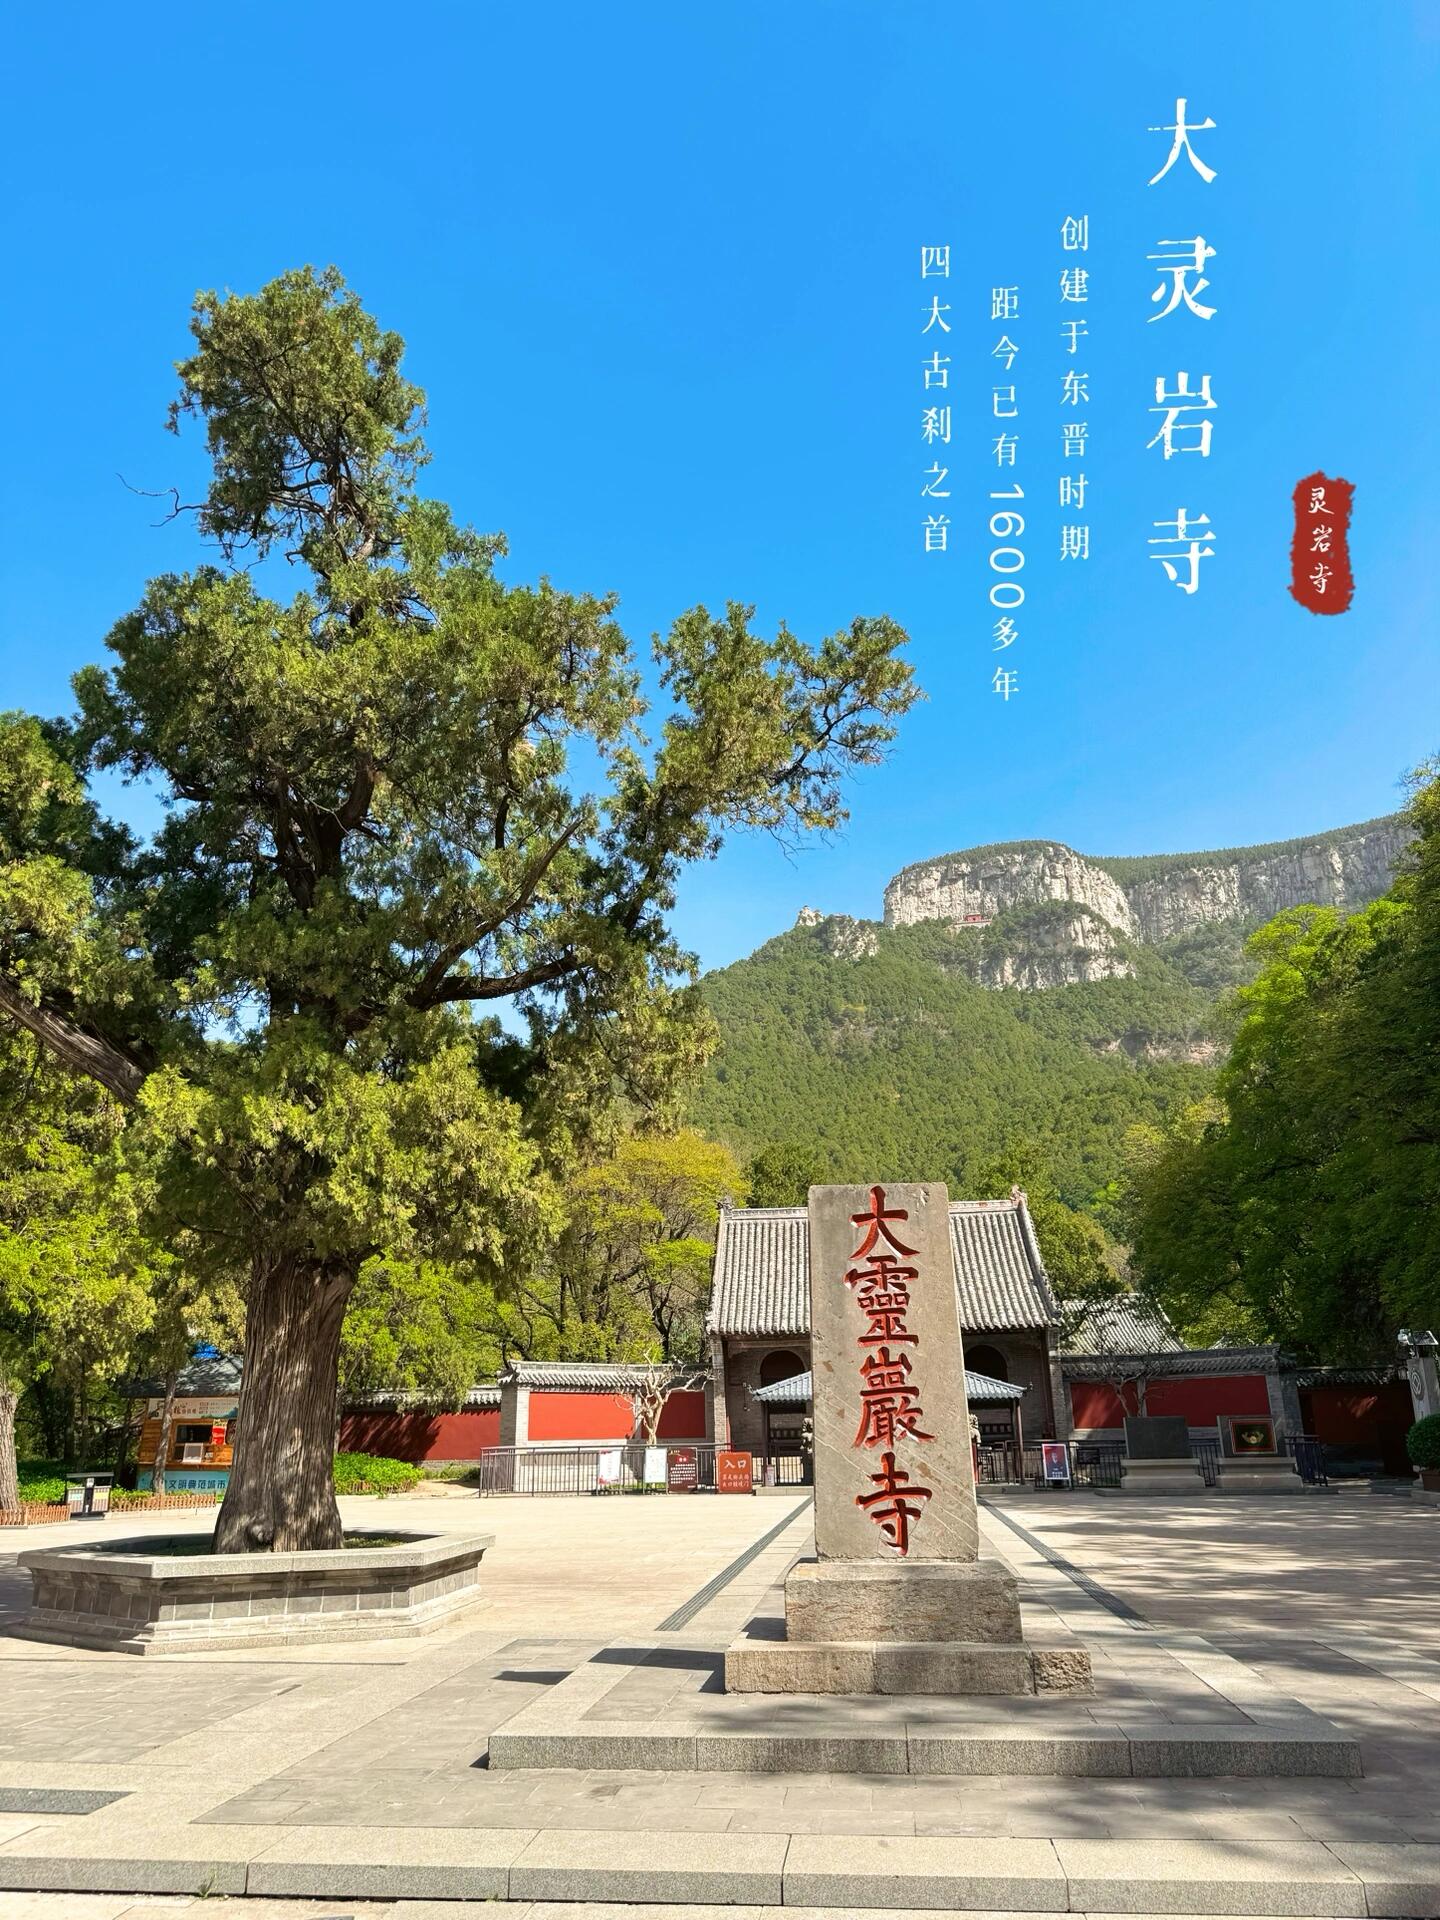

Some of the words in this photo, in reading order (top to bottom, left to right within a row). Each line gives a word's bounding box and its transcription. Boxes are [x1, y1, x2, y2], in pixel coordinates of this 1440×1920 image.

[723, 1459, 747, 1469] 入口
[150, 1479, 226, 1489] 文明典范城市
